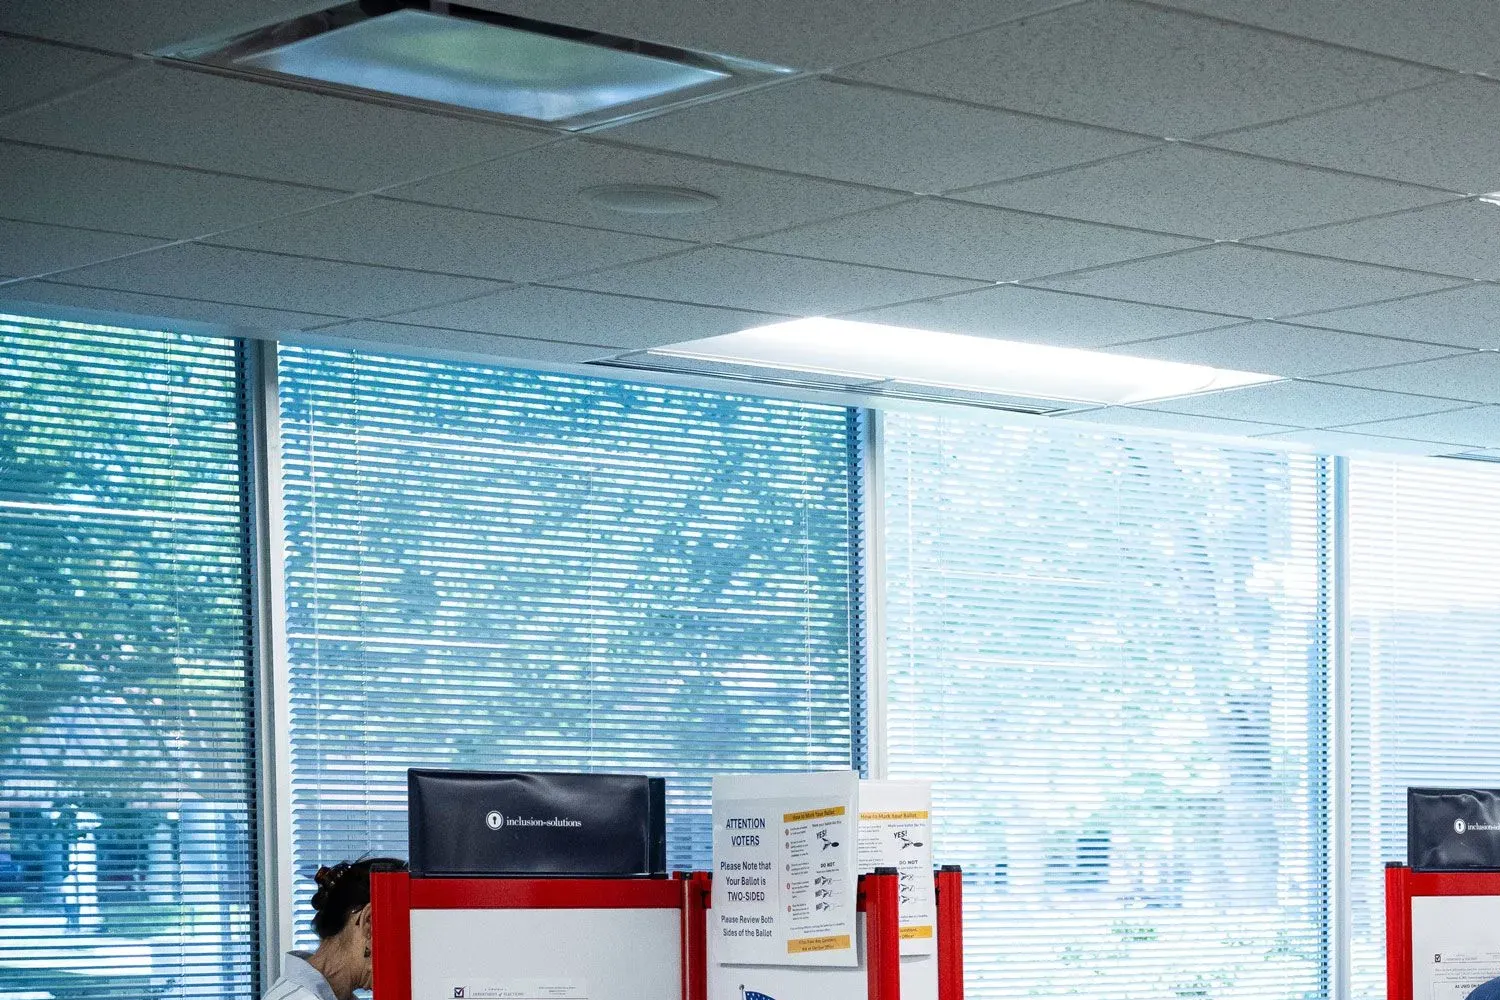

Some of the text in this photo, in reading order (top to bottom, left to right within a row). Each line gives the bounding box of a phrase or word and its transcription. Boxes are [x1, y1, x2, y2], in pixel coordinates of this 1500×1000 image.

[507, 816, 581, 827] inclusion-solutions
[726, 818, 765, 828] ATTENTION
[894, 830, 908, 839] YES!
[732, 835, 759, 846] VOTERS
[721, 862, 771, 871] Please Note that
[726, 877, 740, 886] Your
[742, 877, 760, 886] Ballot
[728, 892, 765, 901] TWO-SIDED
[721, 915, 738, 923] Please
[723, 928, 737, 937] Sides
[756, 929, 772, 937] Ballot
